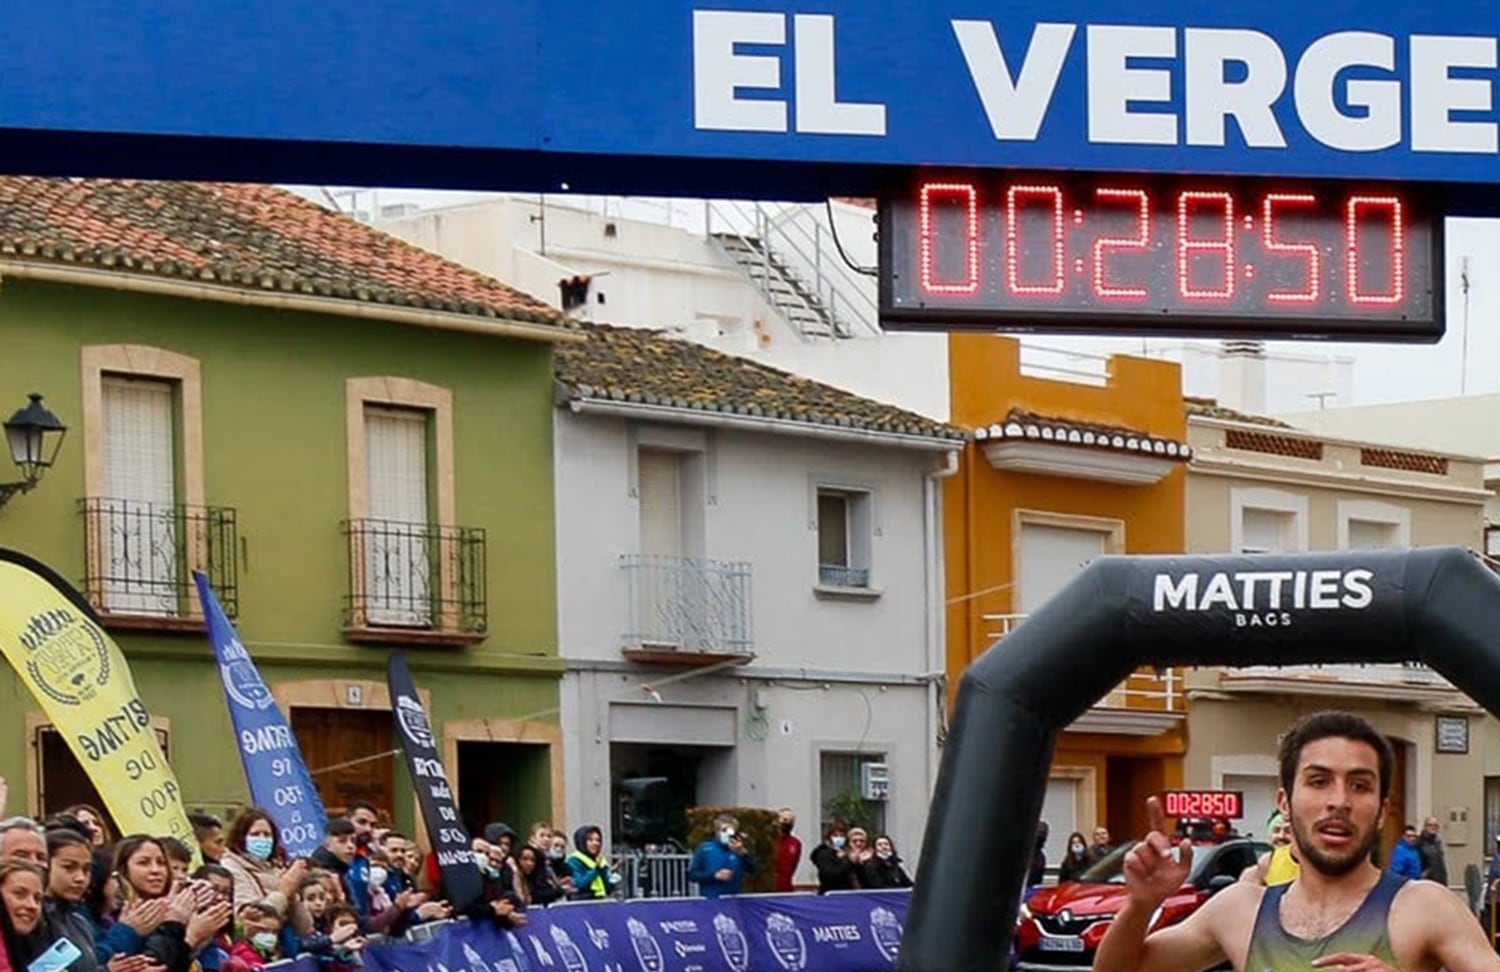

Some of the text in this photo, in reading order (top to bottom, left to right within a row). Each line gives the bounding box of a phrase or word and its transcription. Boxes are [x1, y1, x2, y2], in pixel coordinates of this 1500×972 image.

[692, 10, 886, 137] EL
[919, 182, 1402, 303] 00:28:50
[1153, 569, 1374, 612] MATTIES
[1235, 612, 1292, 627] BAGS
